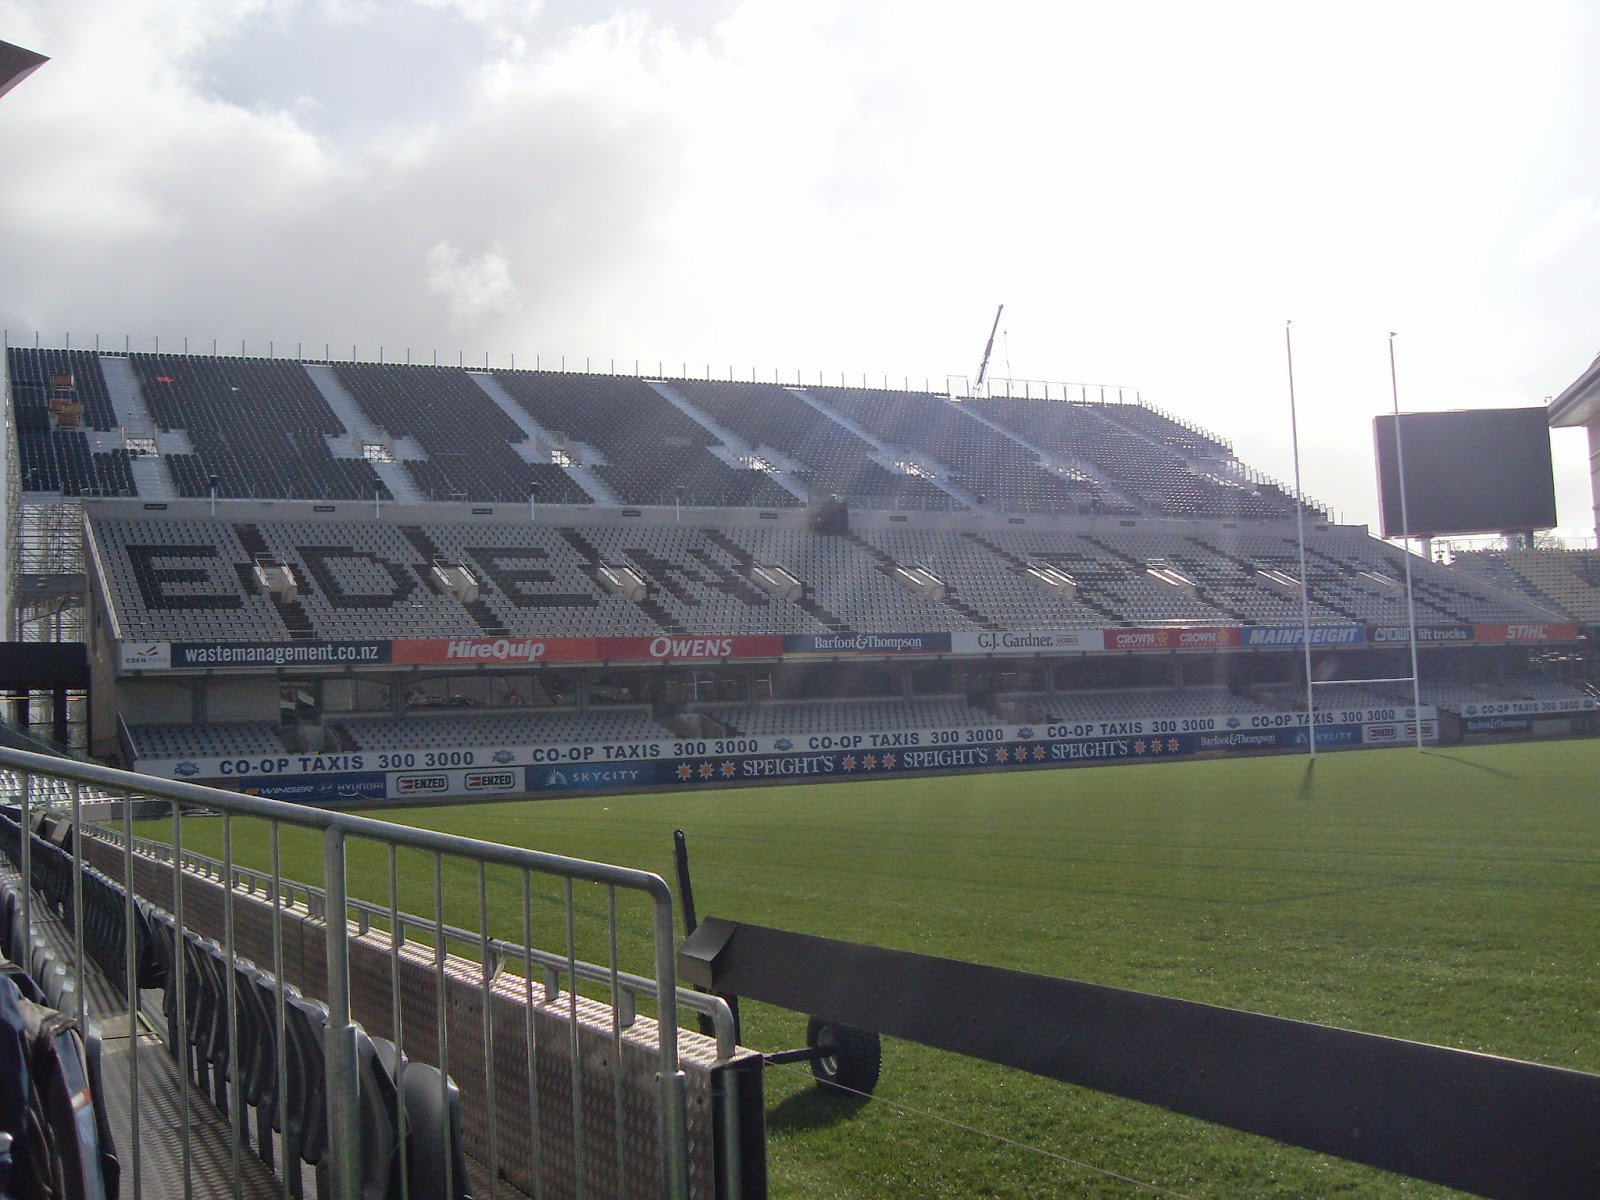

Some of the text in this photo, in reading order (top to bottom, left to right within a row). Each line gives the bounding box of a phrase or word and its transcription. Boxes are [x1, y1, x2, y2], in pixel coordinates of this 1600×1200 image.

[1116, 633, 1155, 644] CROWN
[1179, 632, 1216, 643] CROWN
[1249, 628, 1358, 644] MAINFREIGHT
[1418, 627, 1432, 640] lift
[1434, 627, 1467, 639] trucks
[1505, 624, 1548, 640] STIHL
[649, 636, 732, 657] OWENS
[978, 633, 1000, 650] G.J.
[185, 643, 379, 663] wastemanagement.co.nz
[447, 639, 545, 662] HireQuip
[1481, 703, 1510, 714] CO-OP
[1513, 702, 1538, 712] TAXIS
[1251, 709, 1395, 727] CO-OP TAXIS 300 3000
[1047, 718, 1215, 738] CO-OP TAXIS 300 3000
[1315, 731, 1352, 742] KYCITY
[808, 728, 1004, 750] CO-OP TAXIS 300 3000
[532, 739, 759, 763] CO-OP TAXIS 300 3000
[1051, 738, 1128, 759] SPEIGHT'S
[219, 751, 474, 775] CO-OP TAXIS 300 3000
[903, 747, 988, 768] SPEIGHT'S
[572, 768, 639, 782] SKYCITY
[742, 756, 834, 777] SPEIGHT'S
[261, 782, 384, 795] WINGER HYUNDAI
[414, 777, 445, 789] ENZED
[482, 774, 512, 786] ENZED
